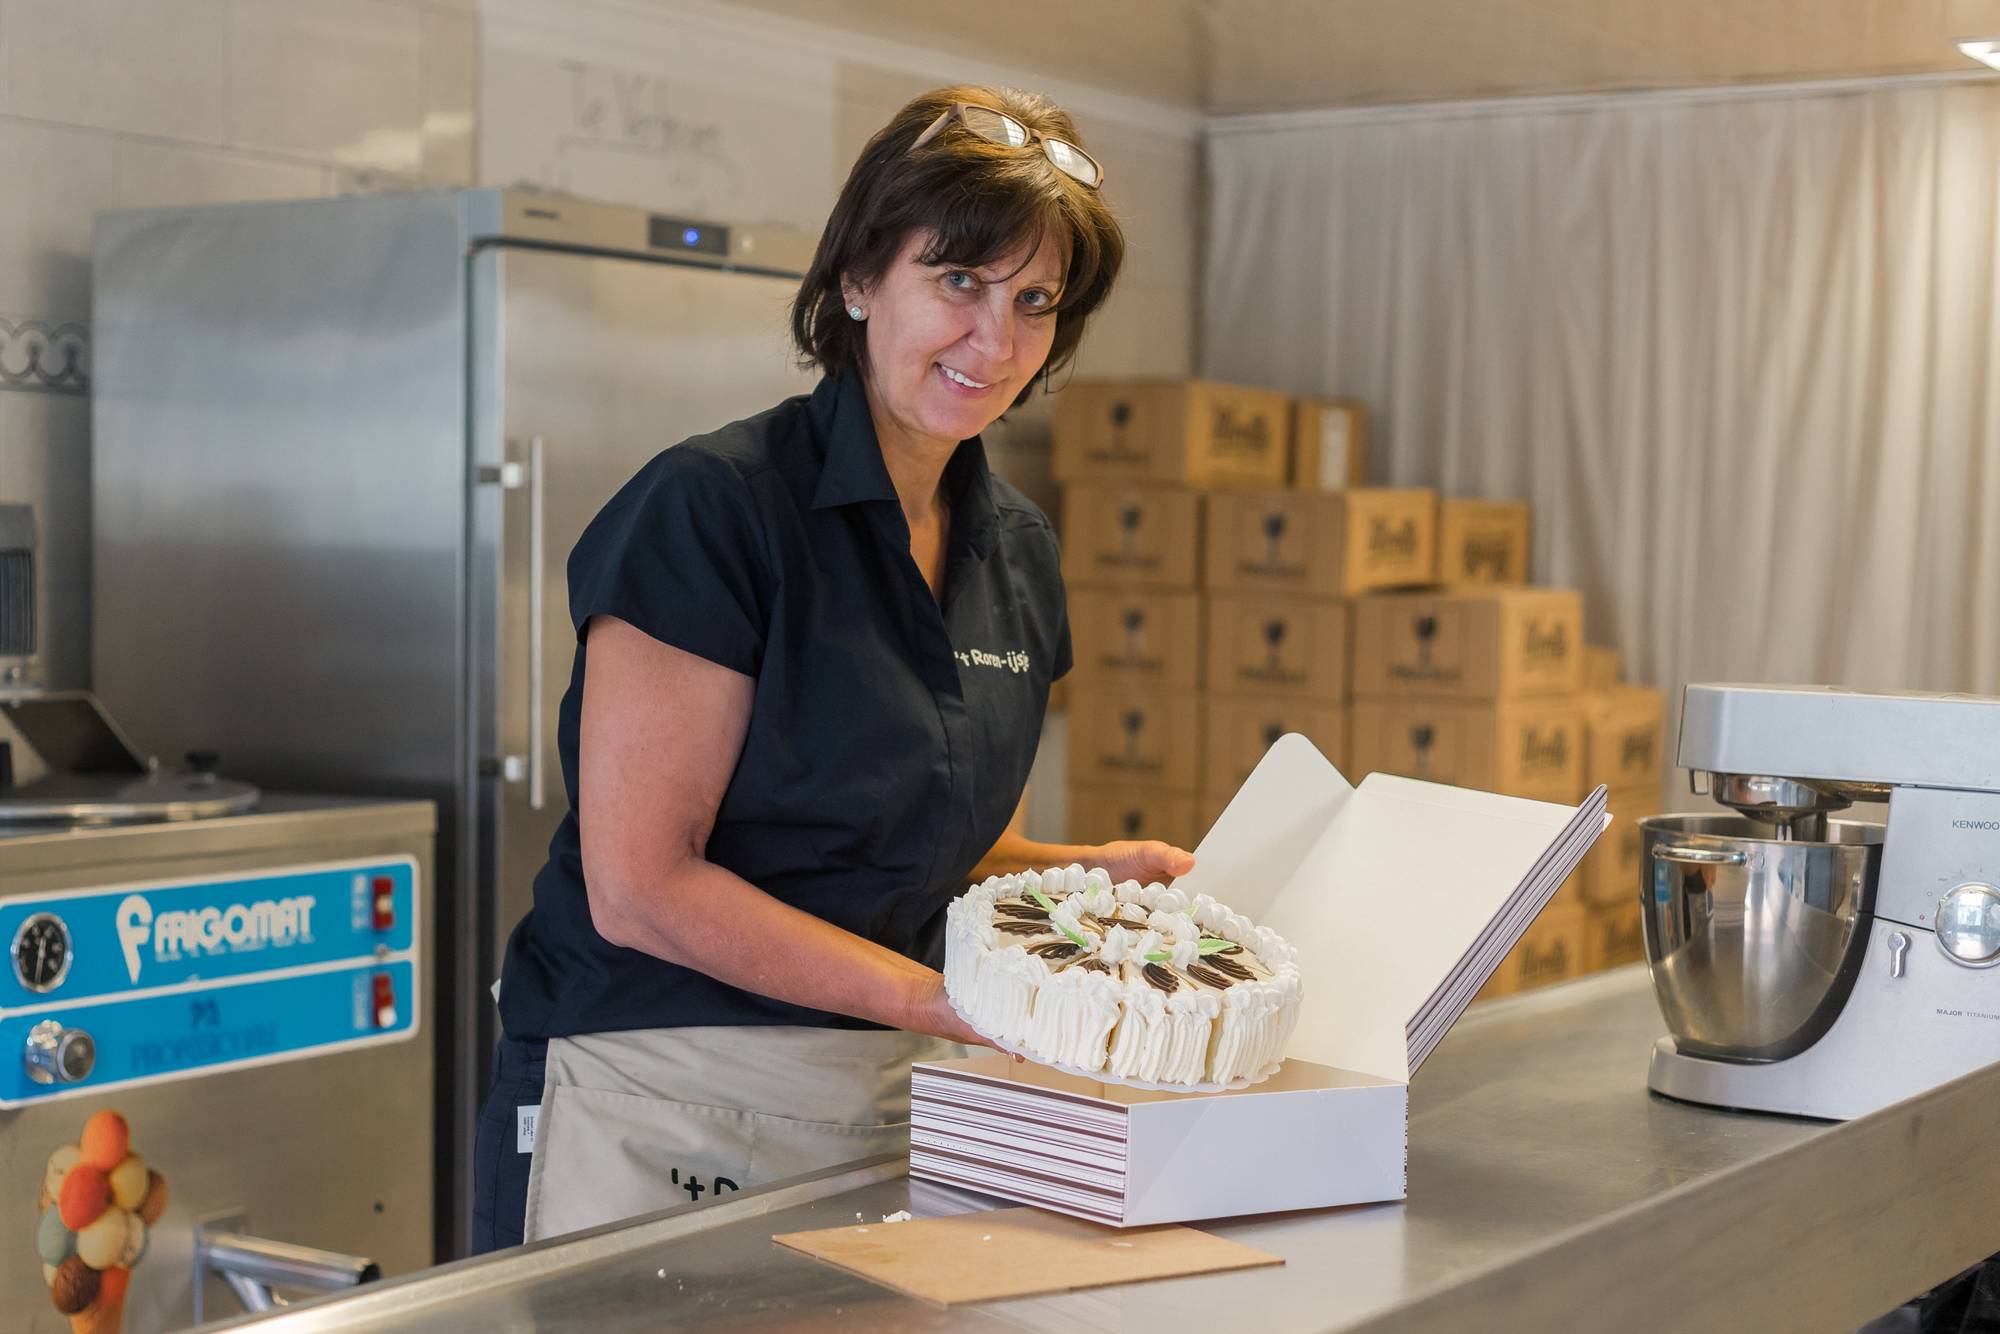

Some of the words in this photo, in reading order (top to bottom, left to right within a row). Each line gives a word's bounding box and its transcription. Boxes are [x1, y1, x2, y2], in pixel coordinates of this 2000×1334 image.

[1952, 818, 2000, 831] KENWOO
[154, 895, 317, 958] FRIGOMAT
[1936, 1008, 1963, 1017] MAJOR
